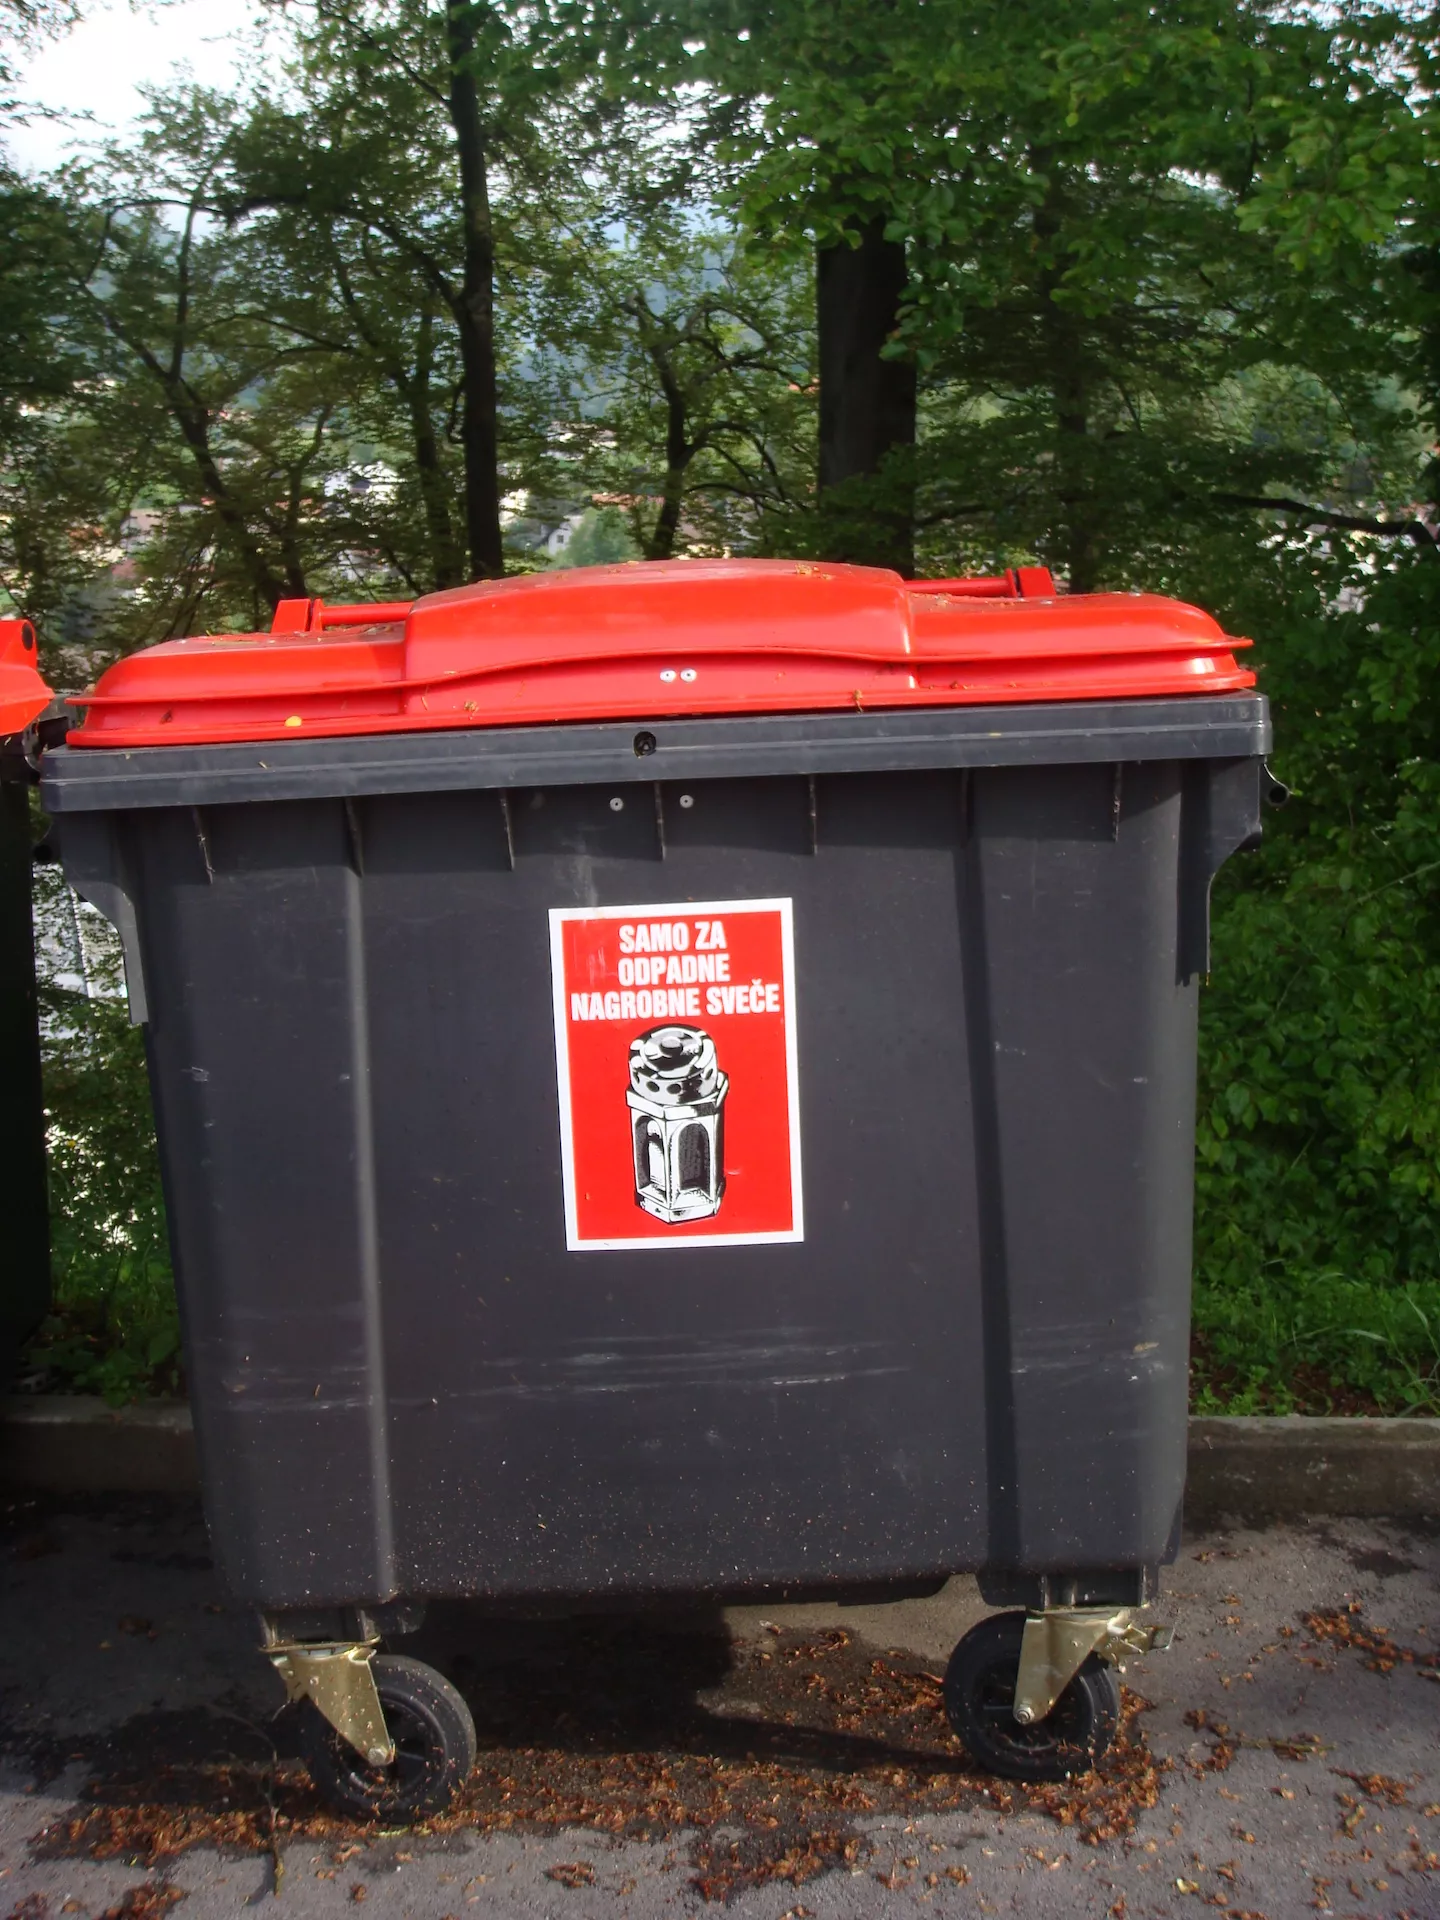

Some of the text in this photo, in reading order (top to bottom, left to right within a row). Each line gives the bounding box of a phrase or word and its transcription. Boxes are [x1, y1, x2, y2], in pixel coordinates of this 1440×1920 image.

[619, 920, 727, 954] SAMO ZA
[618, 953, 730, 986] ODPADNE
[571, 979, 781, 1021] NAGROBNE SVEČE
